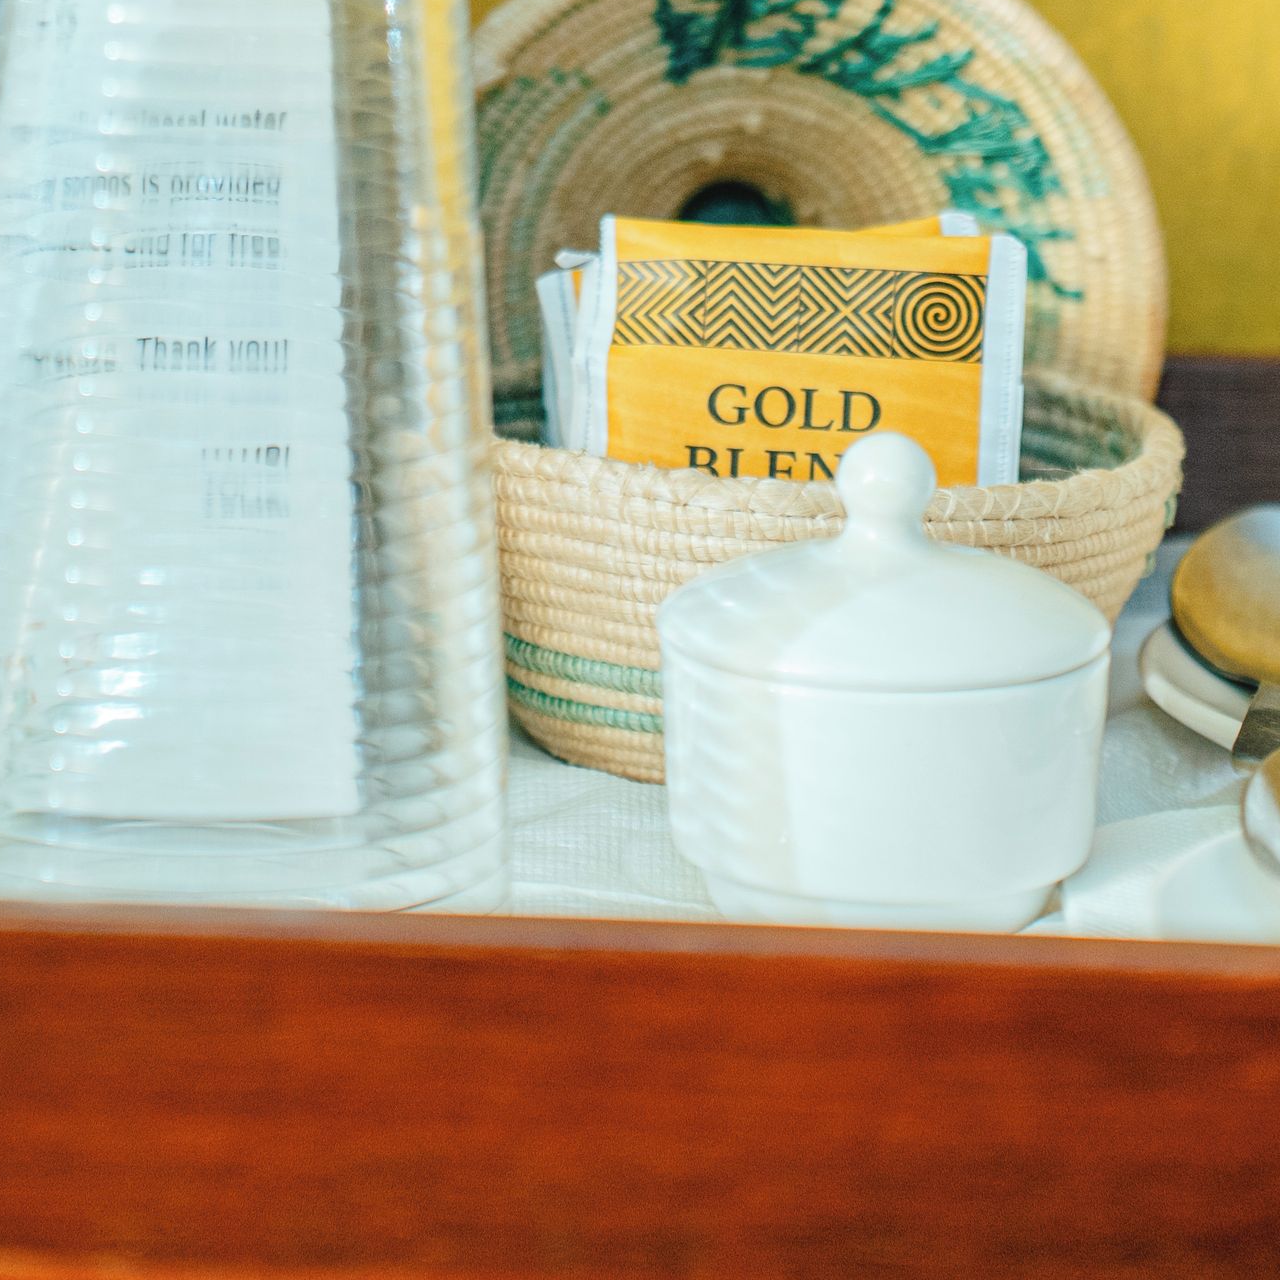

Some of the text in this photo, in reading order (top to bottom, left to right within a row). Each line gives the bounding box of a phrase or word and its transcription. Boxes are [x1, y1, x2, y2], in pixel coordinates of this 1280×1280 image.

[136, 335, 217, 372] Thank
[706, 382, 883, 434] GOLD
[684, 444, 846, 481] BLEN
